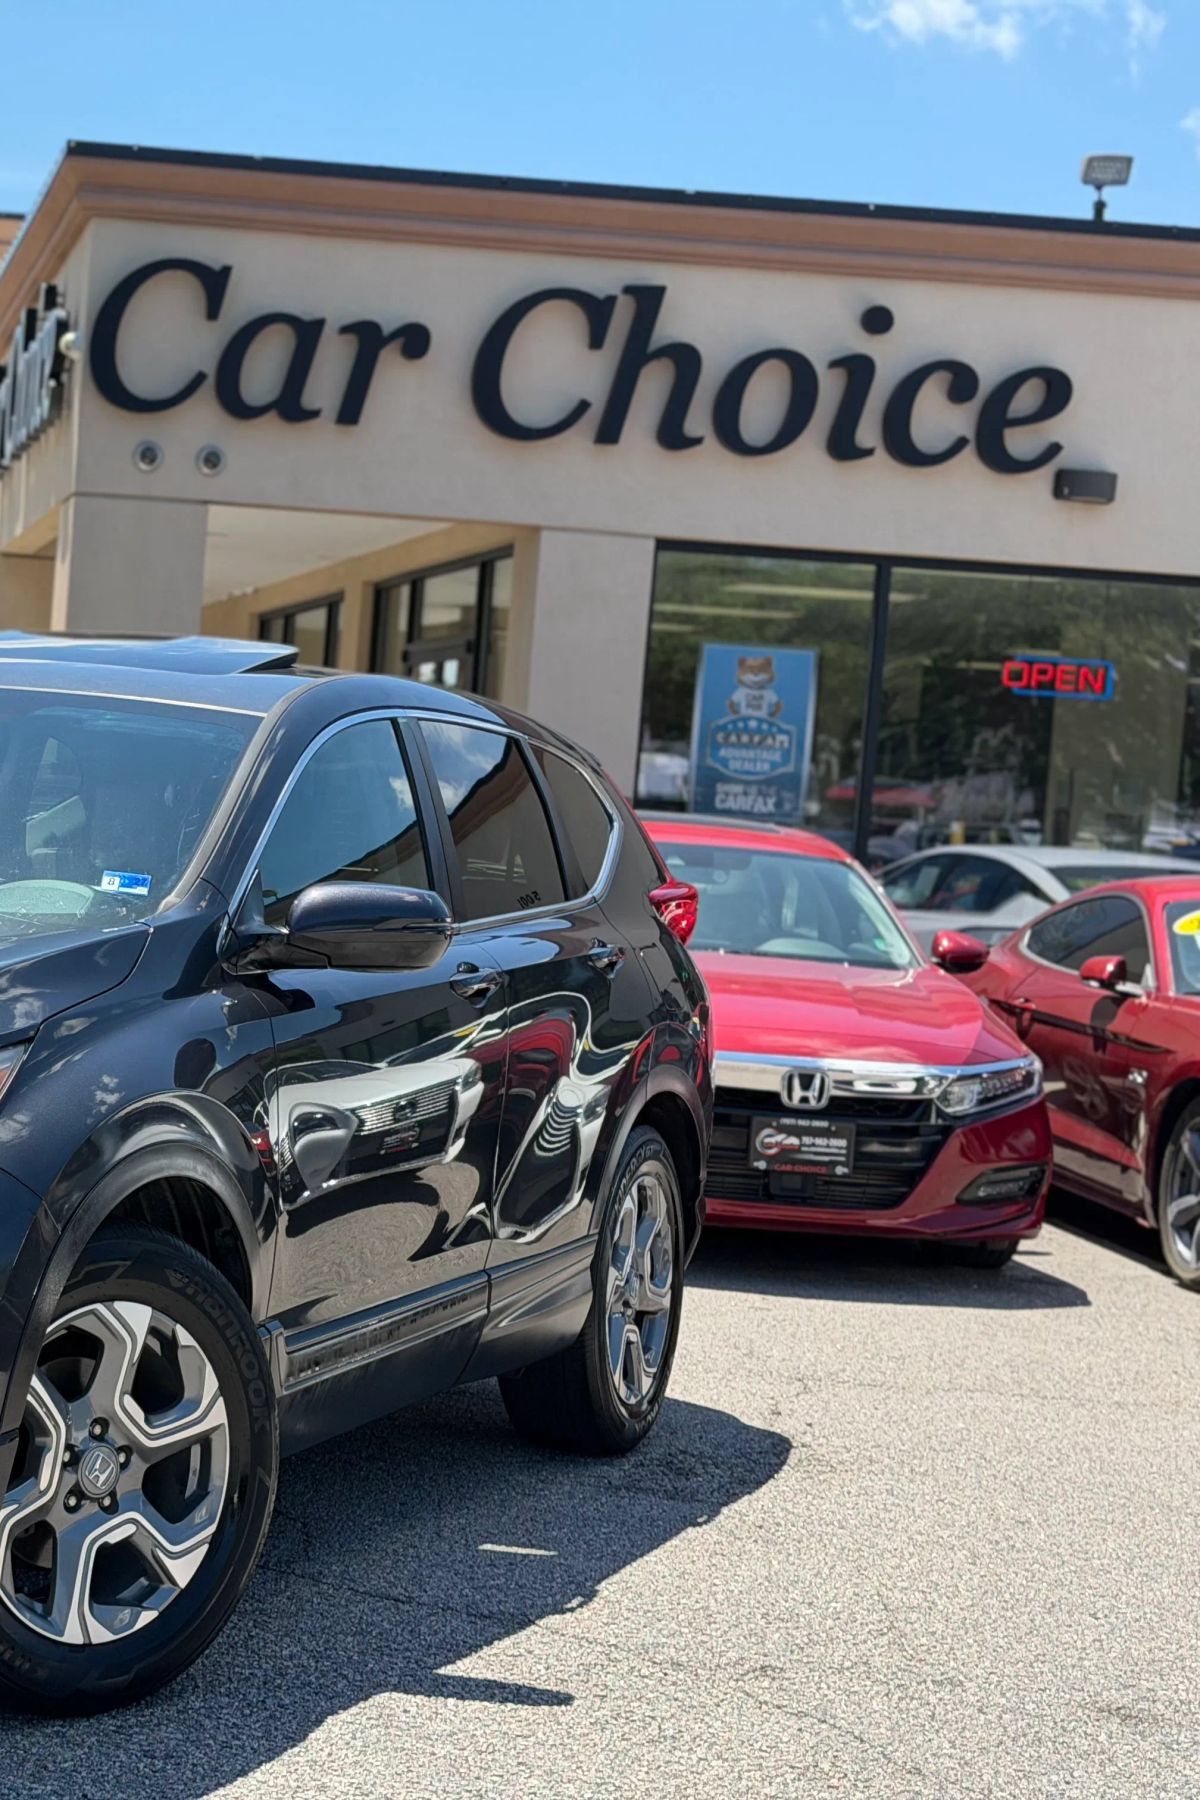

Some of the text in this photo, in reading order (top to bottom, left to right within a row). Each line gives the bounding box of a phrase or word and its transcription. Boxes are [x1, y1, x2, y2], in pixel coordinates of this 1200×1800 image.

[88, 258, 430, 426] Car
[471, 285, 1072, 474] Choice
[1002, 660, 1105, 694] OPEN
